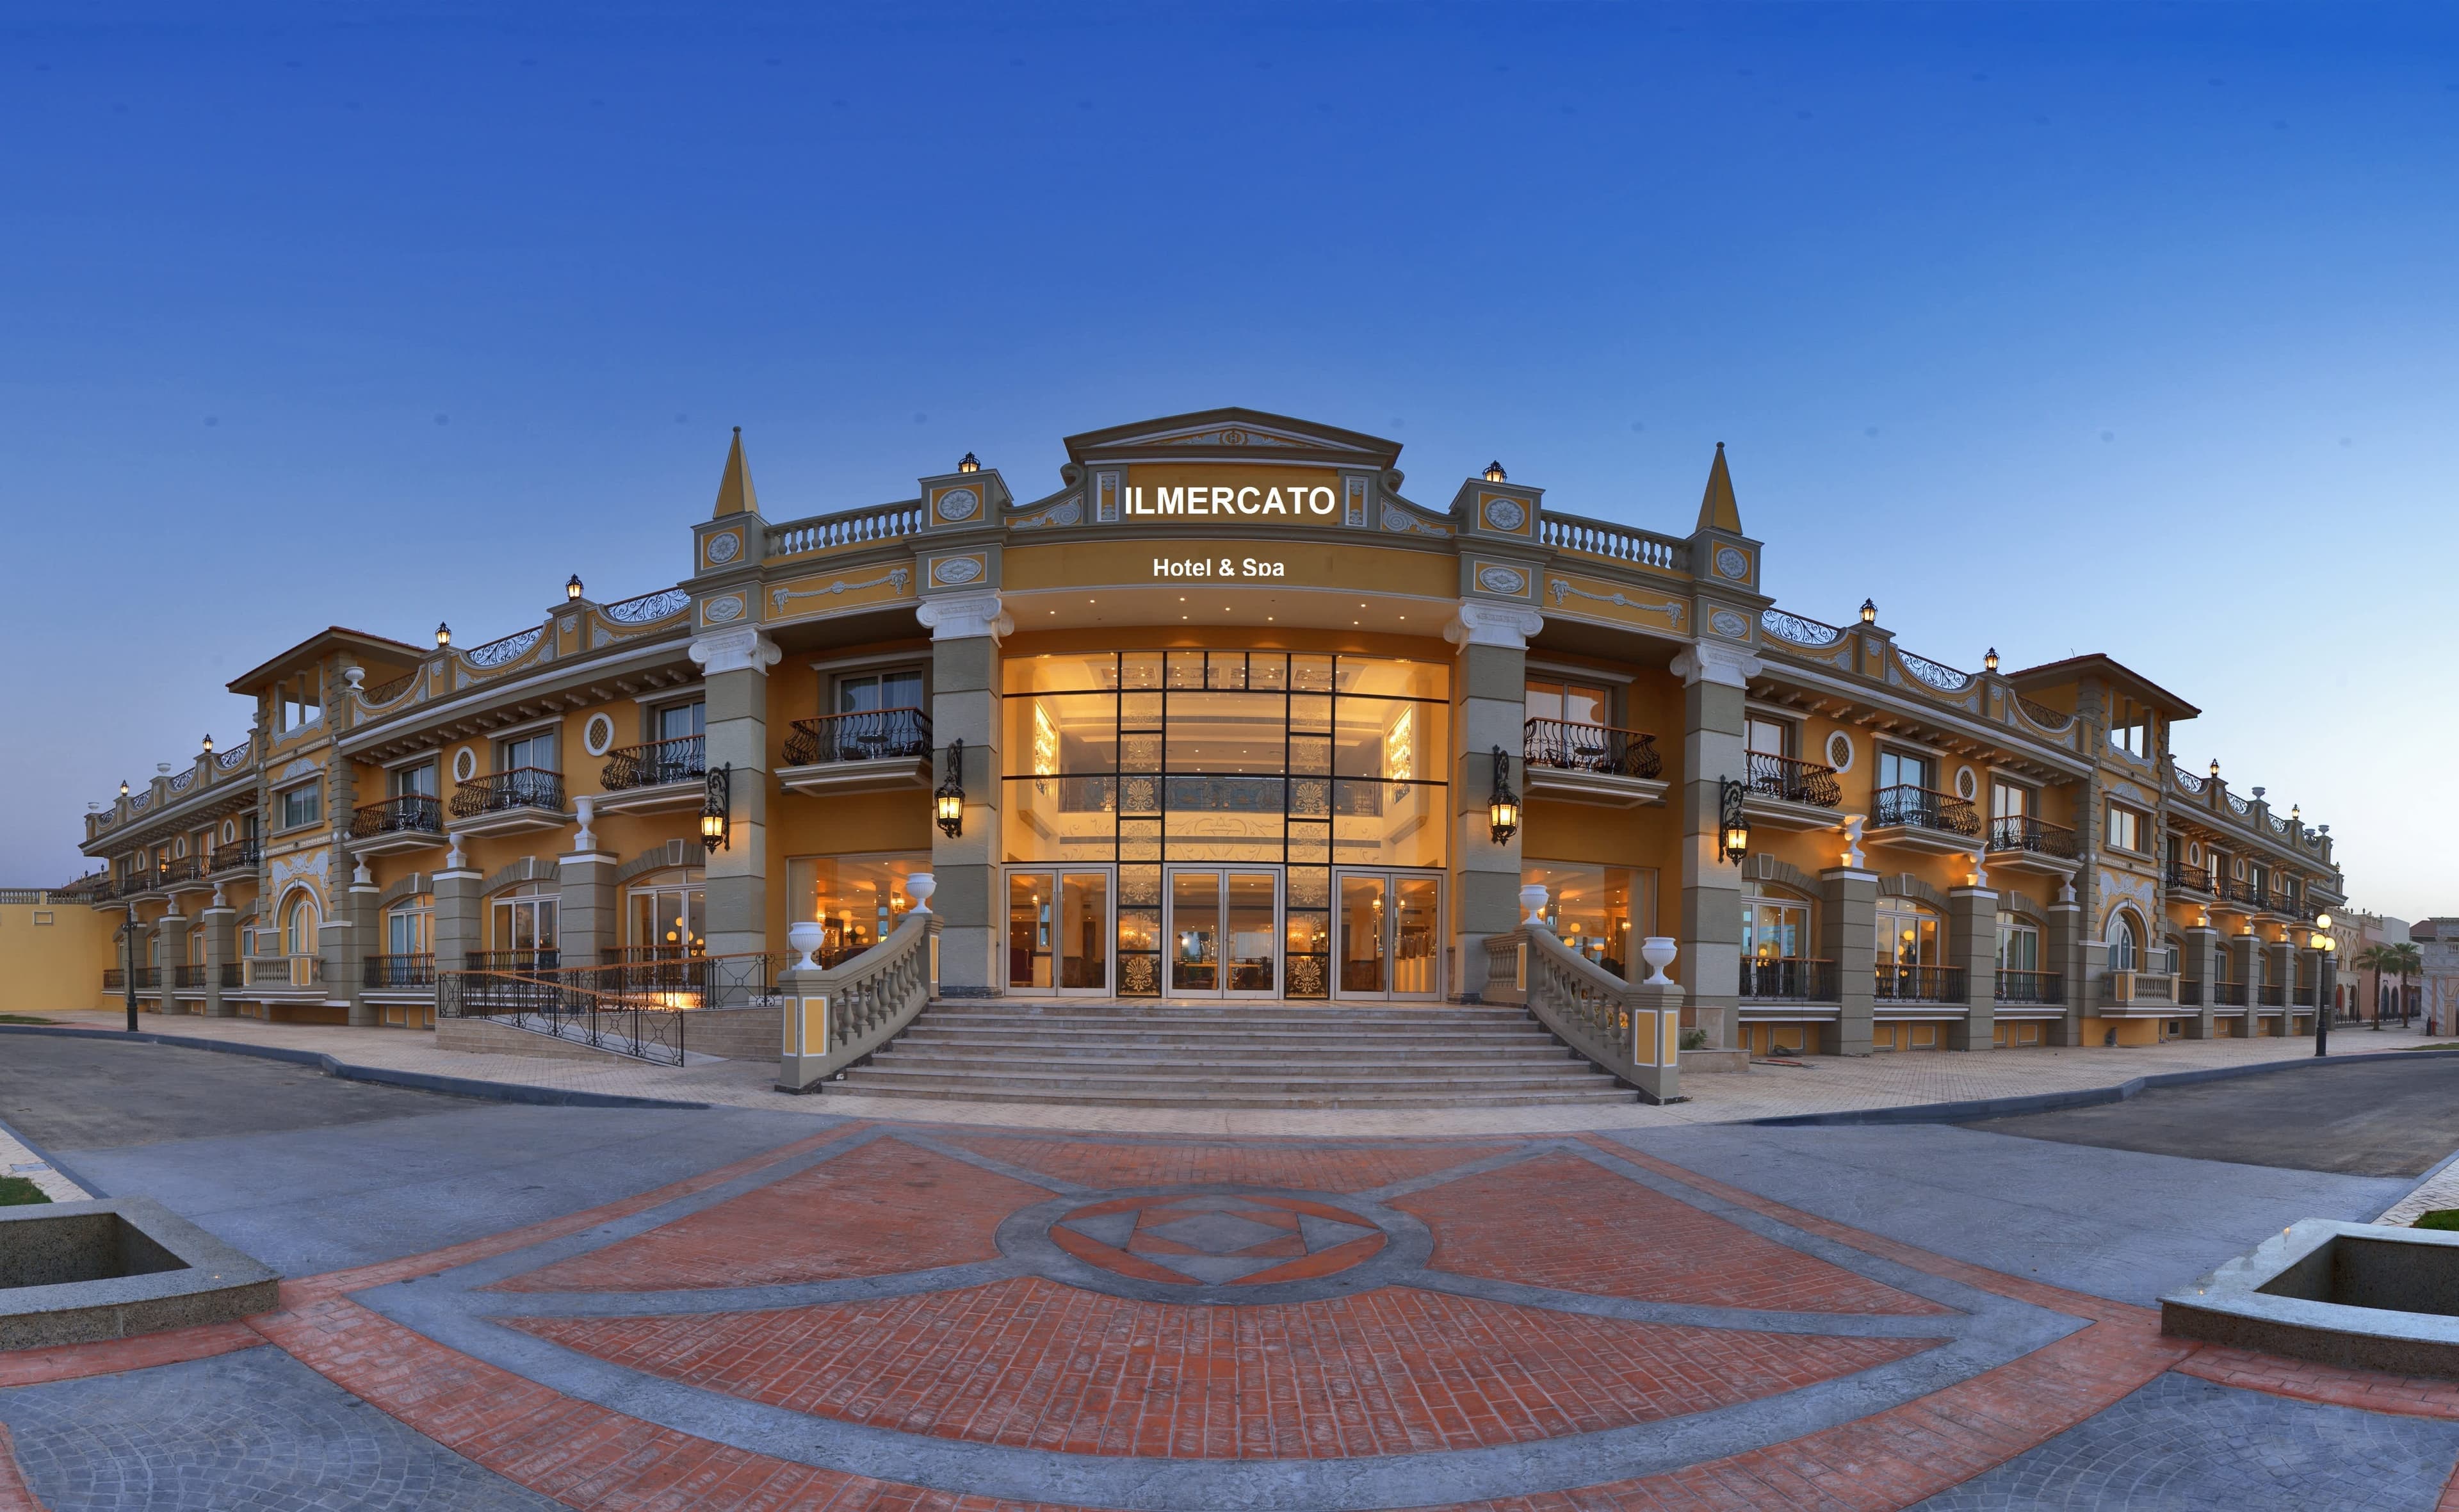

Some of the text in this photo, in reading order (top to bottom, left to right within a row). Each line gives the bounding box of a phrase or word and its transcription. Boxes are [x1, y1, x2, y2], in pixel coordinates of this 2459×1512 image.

[1125, 486, 1335, 515] ILMERCATO
[1153, 558, 1285, 576] Hotel & Spa
